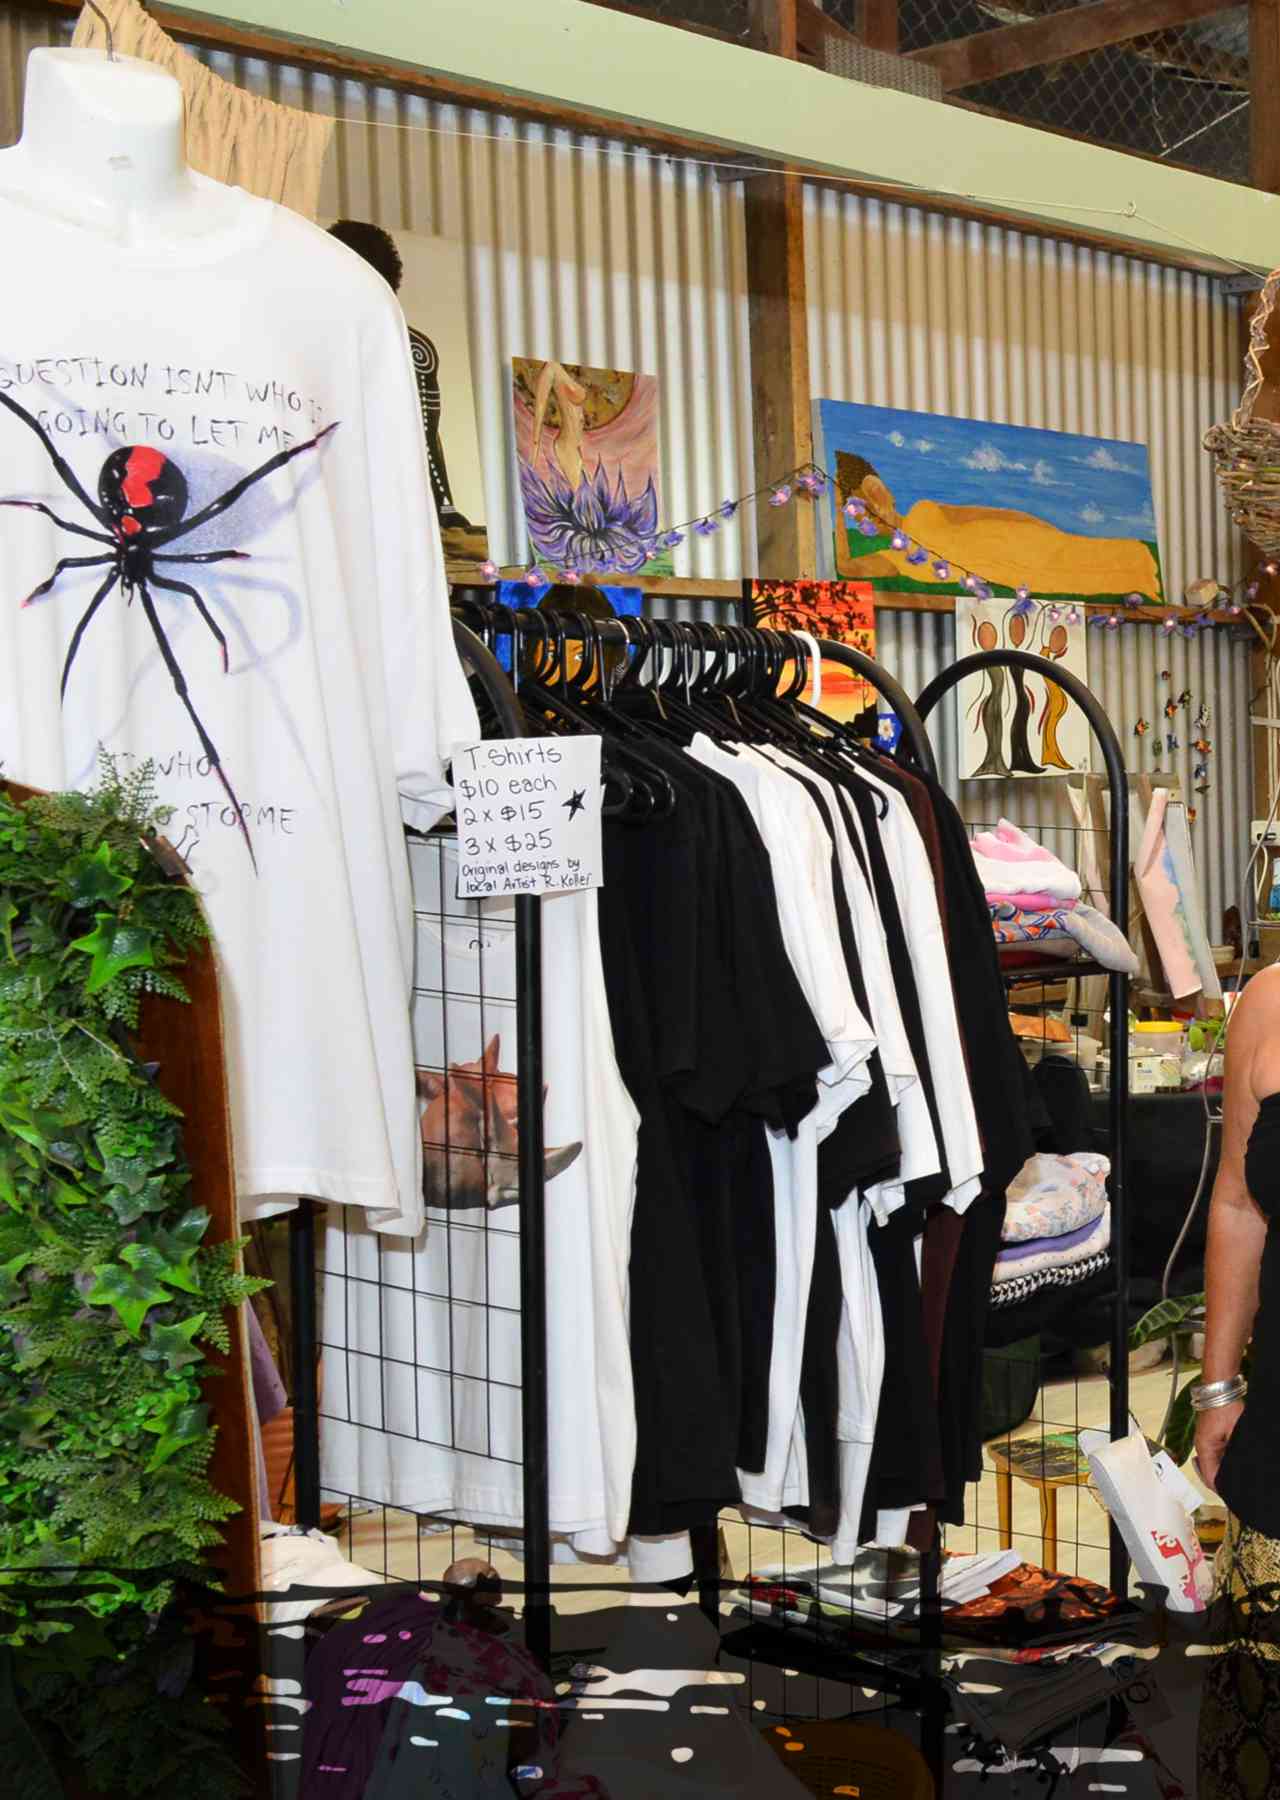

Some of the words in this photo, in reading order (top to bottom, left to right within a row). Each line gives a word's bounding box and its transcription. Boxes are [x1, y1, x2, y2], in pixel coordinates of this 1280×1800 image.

[246, 380, 302, 412] WHO
[36, 407, 128, 437] GOING
[137, 412, 175, 441] TO
[192, 415, 249, 447] LET
[258, 425, 295, 447] ME
[459, 777, 500, 800] $10
[508, 774, 558, 796] each
[256, 806, 297, 834] ME
[463, 807, 478, 826] 2
[483, 809, 494, 824] x
[501, 800, 545, 822] $15
[464, 837, 481, 856] 3
[485, 838, 497, 854] x
[504, 828, 553, 854] $25
[462, 860, 510, 883] Original
[513, 858, 560, 881] designs
[567, 857, 581, 873] by
